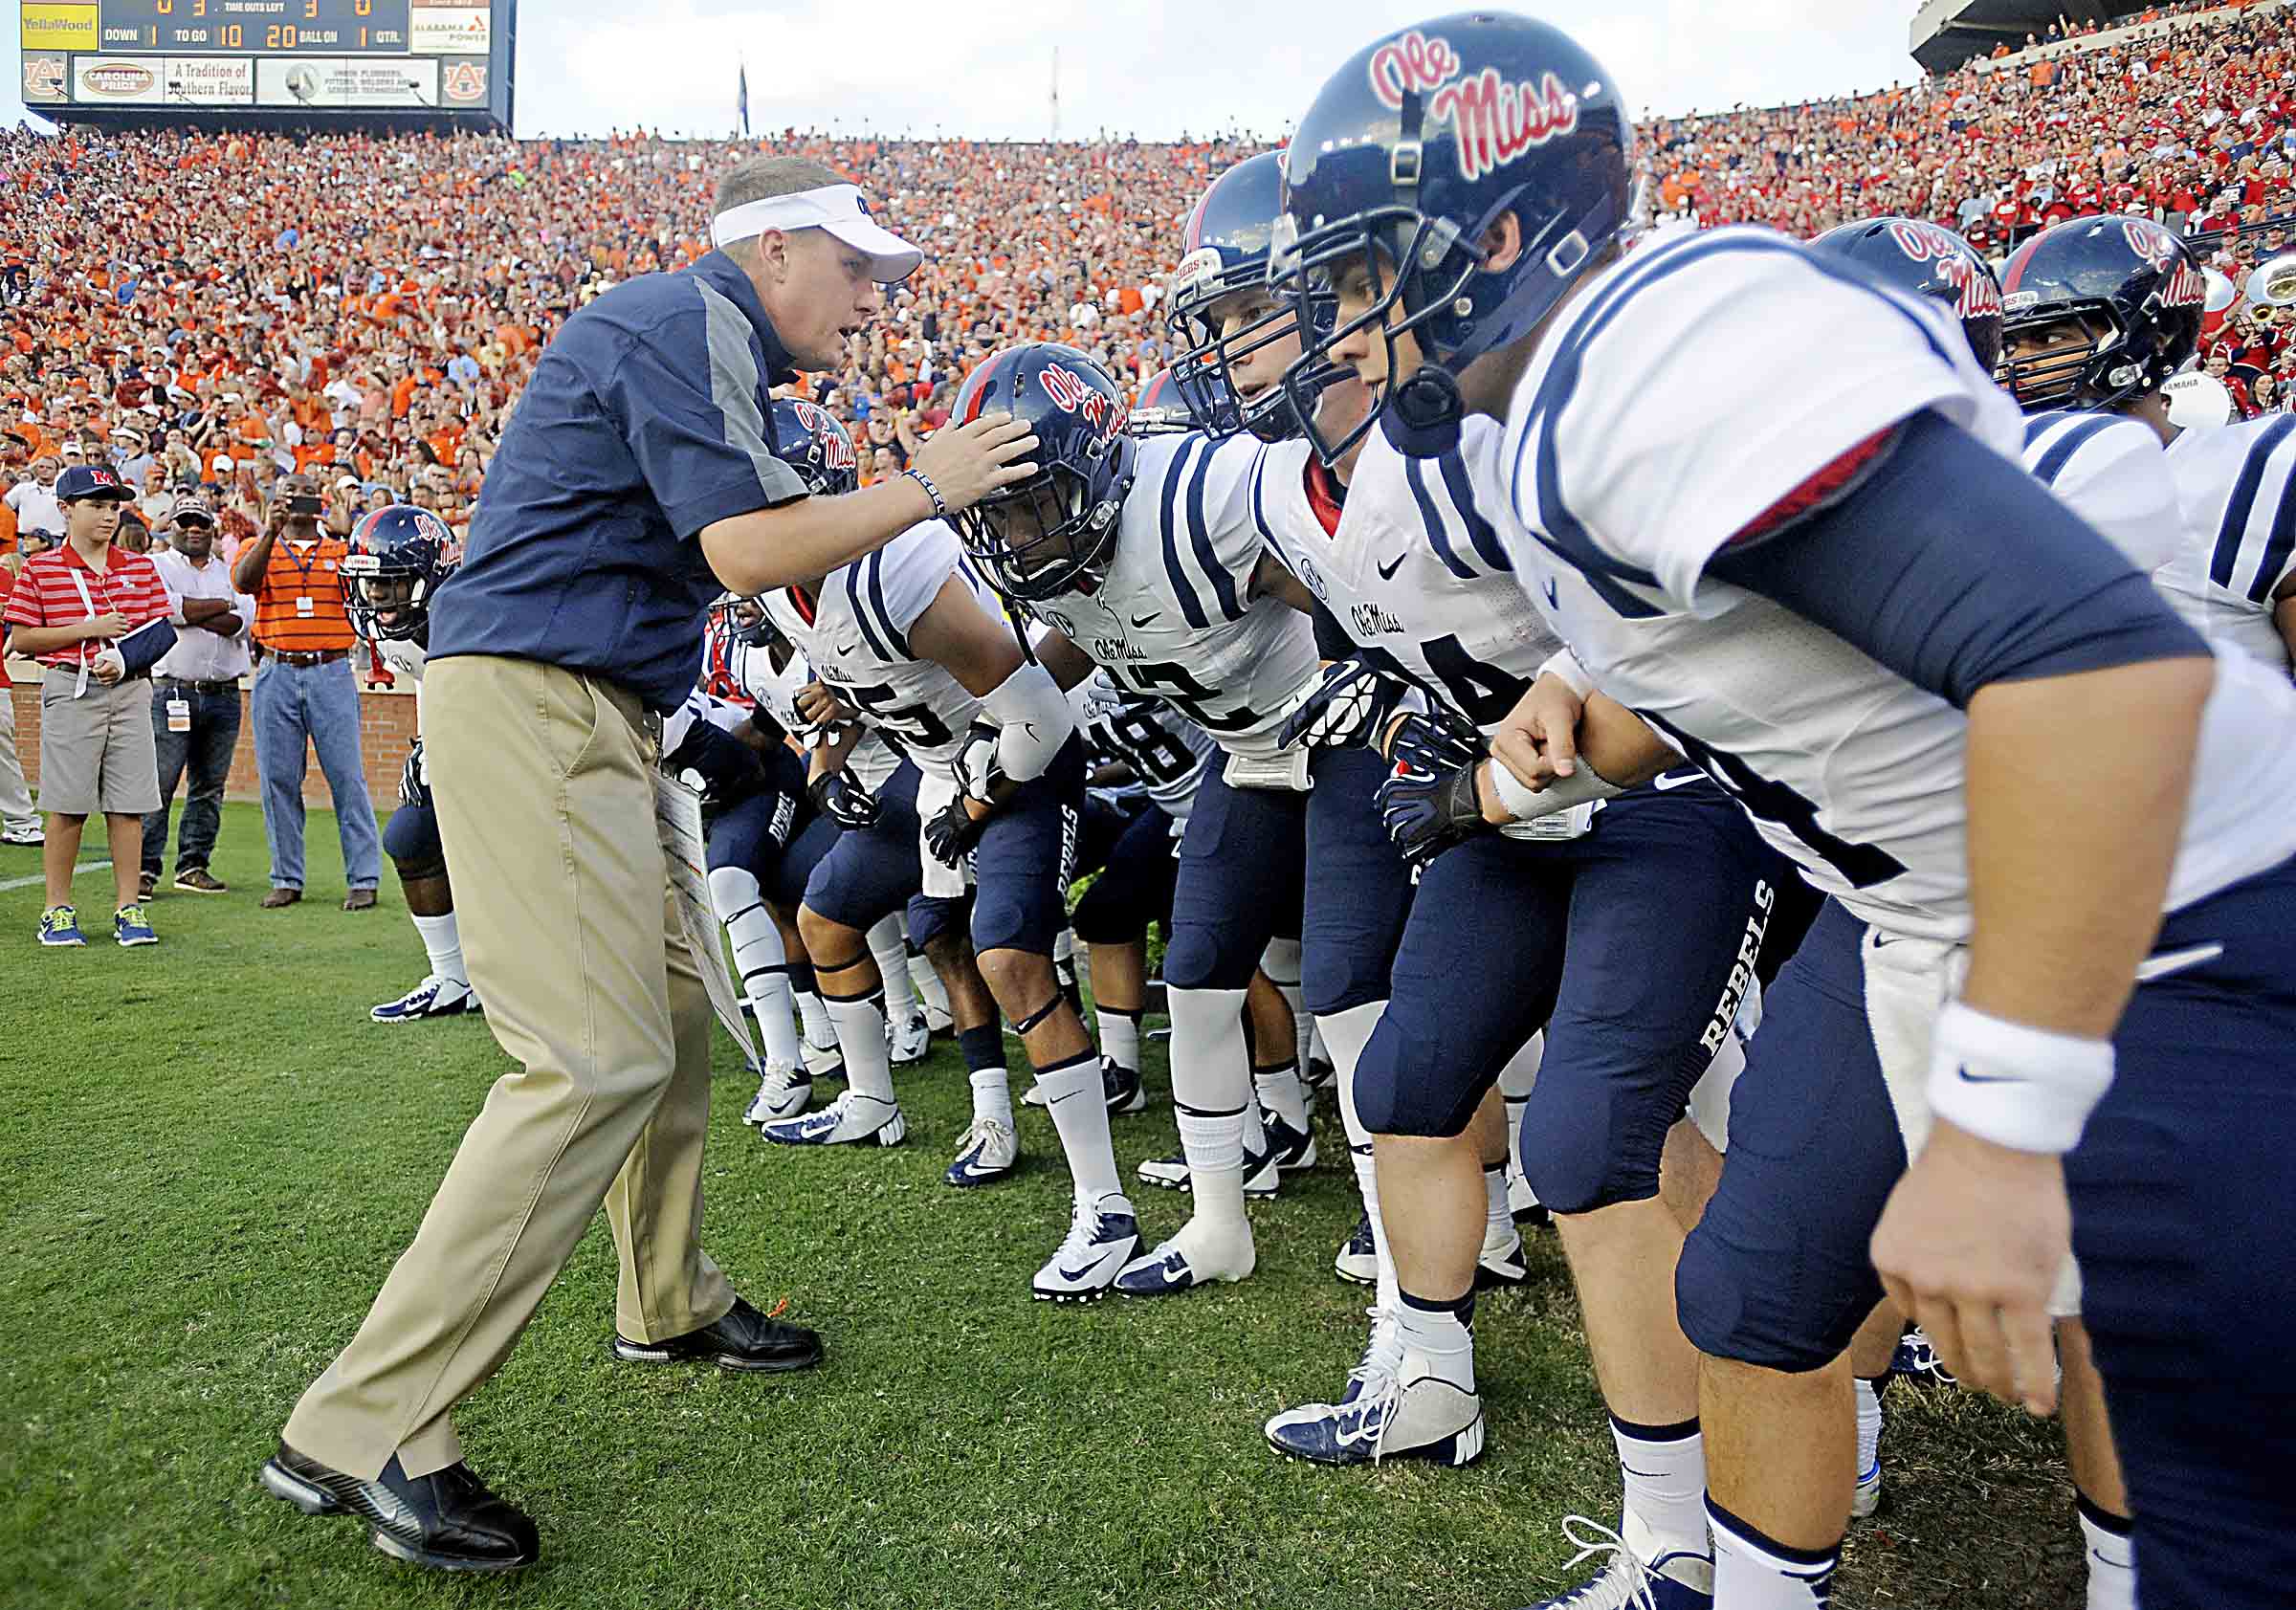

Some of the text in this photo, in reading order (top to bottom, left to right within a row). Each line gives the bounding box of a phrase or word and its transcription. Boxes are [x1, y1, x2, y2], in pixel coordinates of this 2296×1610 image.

[225, 3, 243, 11] TIME
[245, 3, 265, 11] OUTS
[266, 3, 284, 11] LEFT
[24, 17, 93, 32] YellaWood
[414, 23, 464, 32] ALABAMA
[105, 29, 138, 41] DOWN
[151, 25, 158, 46] 1
[175, 30, 188, 41] TO
[191, 30, 207, 41] GO
[221, 24, 242, 47] 10
[266, 23, 297, 48] 20
[298, 31, 322, 43] BALL
[323, 31, 338, 43] ON
[360, 26, 367, 47] 1
[449, 33, 487, 41] POWER
[88, 72, 149, 82] CAROLINA
[175, 63, 247, 77] A Tradition of
[1370, 31, 1460, 107] Ole
[100, 81, 139, 92] PRIDE
[1433, 66, 1578, 181] Miss
[1039, 363, 1093, 413] Ole
[1351, 603, 1405, 637] Ole Miss
[1094, 638, 1148, 660] Ole Miss
[1699, 879, 1775, 1057] REBELS
